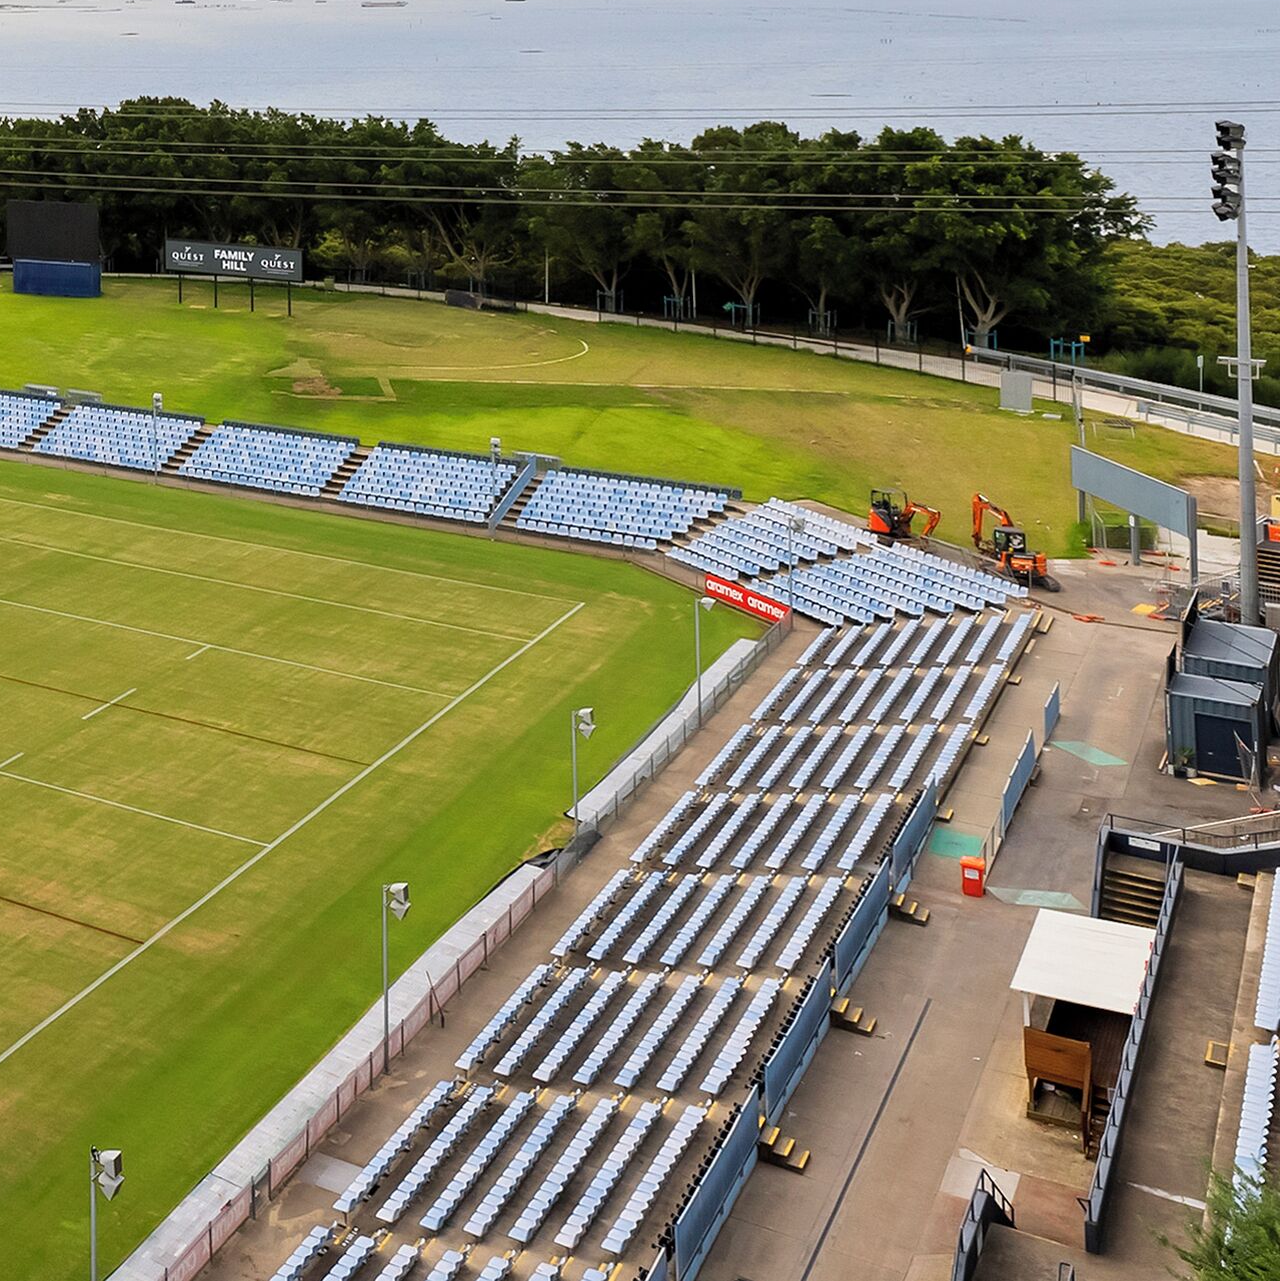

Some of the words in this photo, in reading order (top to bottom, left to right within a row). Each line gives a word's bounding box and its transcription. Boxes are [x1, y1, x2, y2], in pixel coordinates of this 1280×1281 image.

[171, 251, 204, 262] QUEST
[214, 249, 255, 262] FAMILY
[222, 260, 247, 271] HILL
[260, 259, 295, 269] QUEST
[706, 580, 743, 602] aramex
[747, 596, 784, 618] aramex
